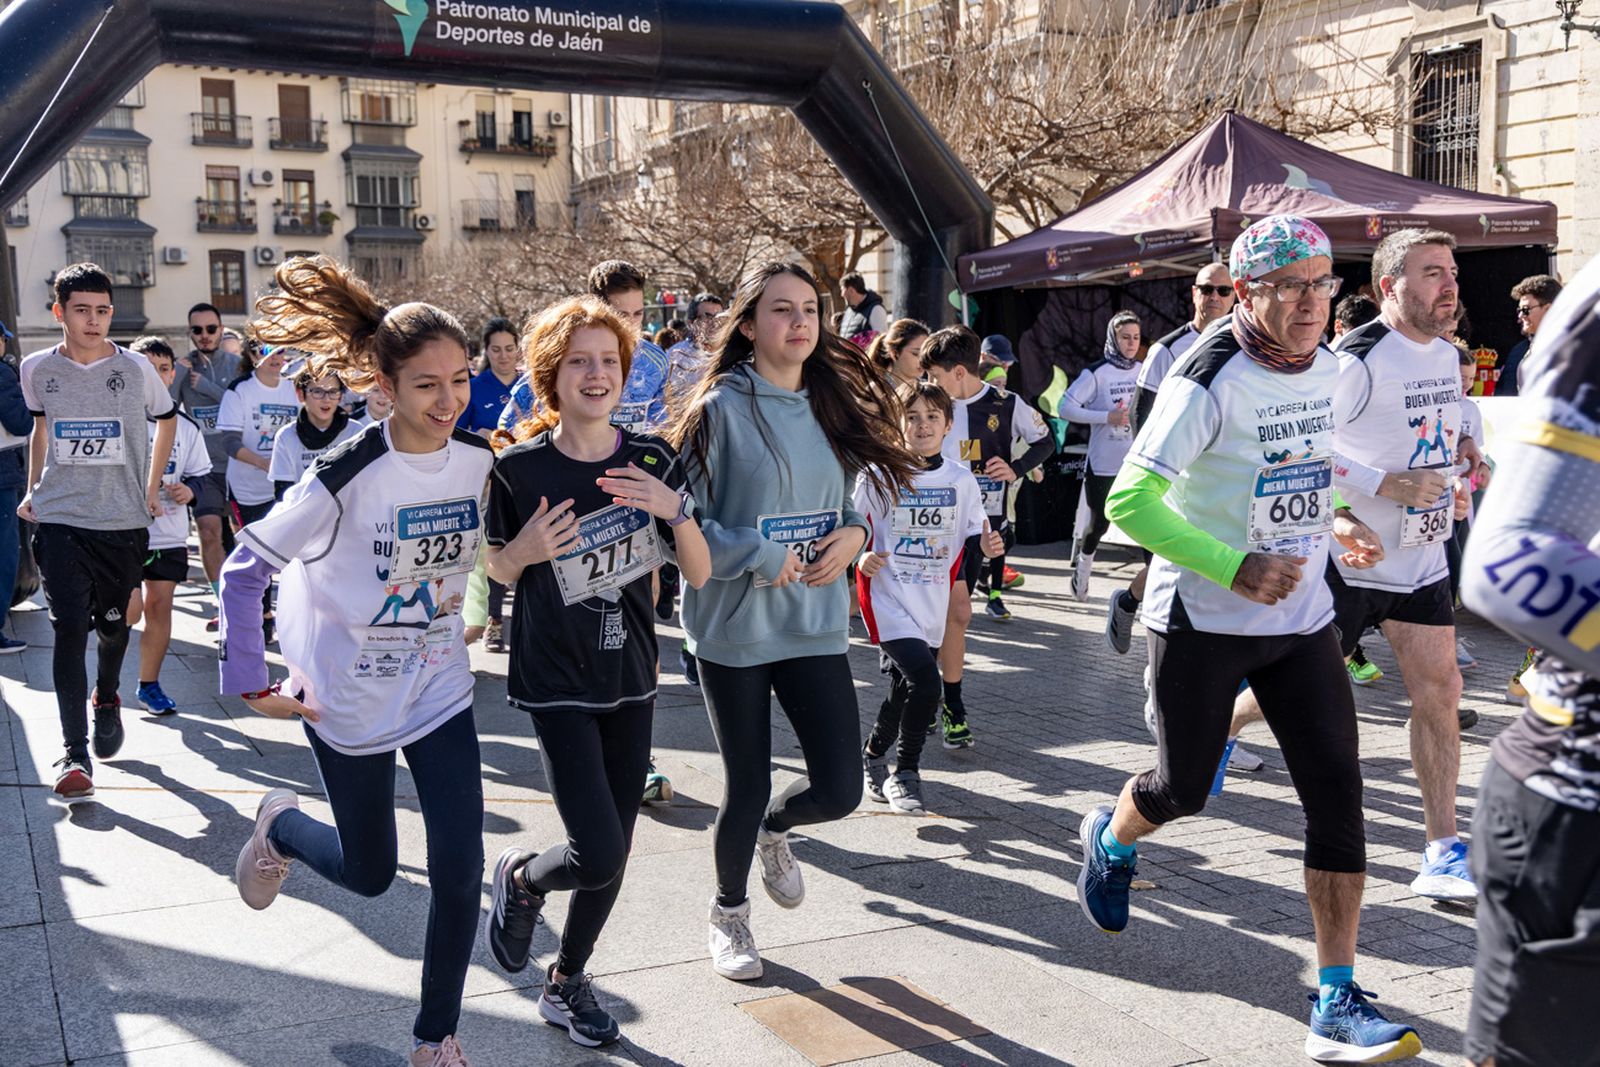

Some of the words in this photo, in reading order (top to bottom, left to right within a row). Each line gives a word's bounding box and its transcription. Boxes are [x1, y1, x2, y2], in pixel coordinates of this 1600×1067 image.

[435, 0, 530, 23] Patronato
[534, 6, 623, 33] Municipal
[628, 15, 651, 33] de
[436, 21, 525, 45] Deportes
[529, 29, 554, 47] de
[558, 31, 604, 51] Jaén
[1405, 393, 1432, 409] BUENA
[1432, 389, 1458, 405] MUERTE
[1255, 408, 1267, 418] VI
[1267, 401, 1307, 417] CARRERA
[1258, 421, 1296, 443] BUENA
[1296, 414, 1329, 437] MUERTE
[69, 439, 106, 455] 767
[1262, 480, 1286, 494] BUENA
[1287, 476, 1316, 491] MUERTE
[414, 507, 443, 519] CARRERA
[443, 503, 471, 515] CAMINATA
[920, 497, 941, 505] MUERTE
[1269, 491, 1320, 523] 608
[601, 506, 638, 525] CAMINATA
[777, 518, 804, 528] CARRERA
[804, 514, 830, 525] CAMINATA
[909, 508, 942, 526] 166
[1419, 508, 1448, 535] 368
[375, 522, 387, 534] VI
[407, 520, 432, 536] BUENA
[432, 516, 460, 532] MUERTE
[591, 521, 627, 546] MUERTE
[769, 529, 792, 541] BUENA
[793, 526, 818, 539] MUERTE
[414, 532, 463, 567] 323
[581, 535, 633, 581] 277
[784, 539, 819, 564] 30
